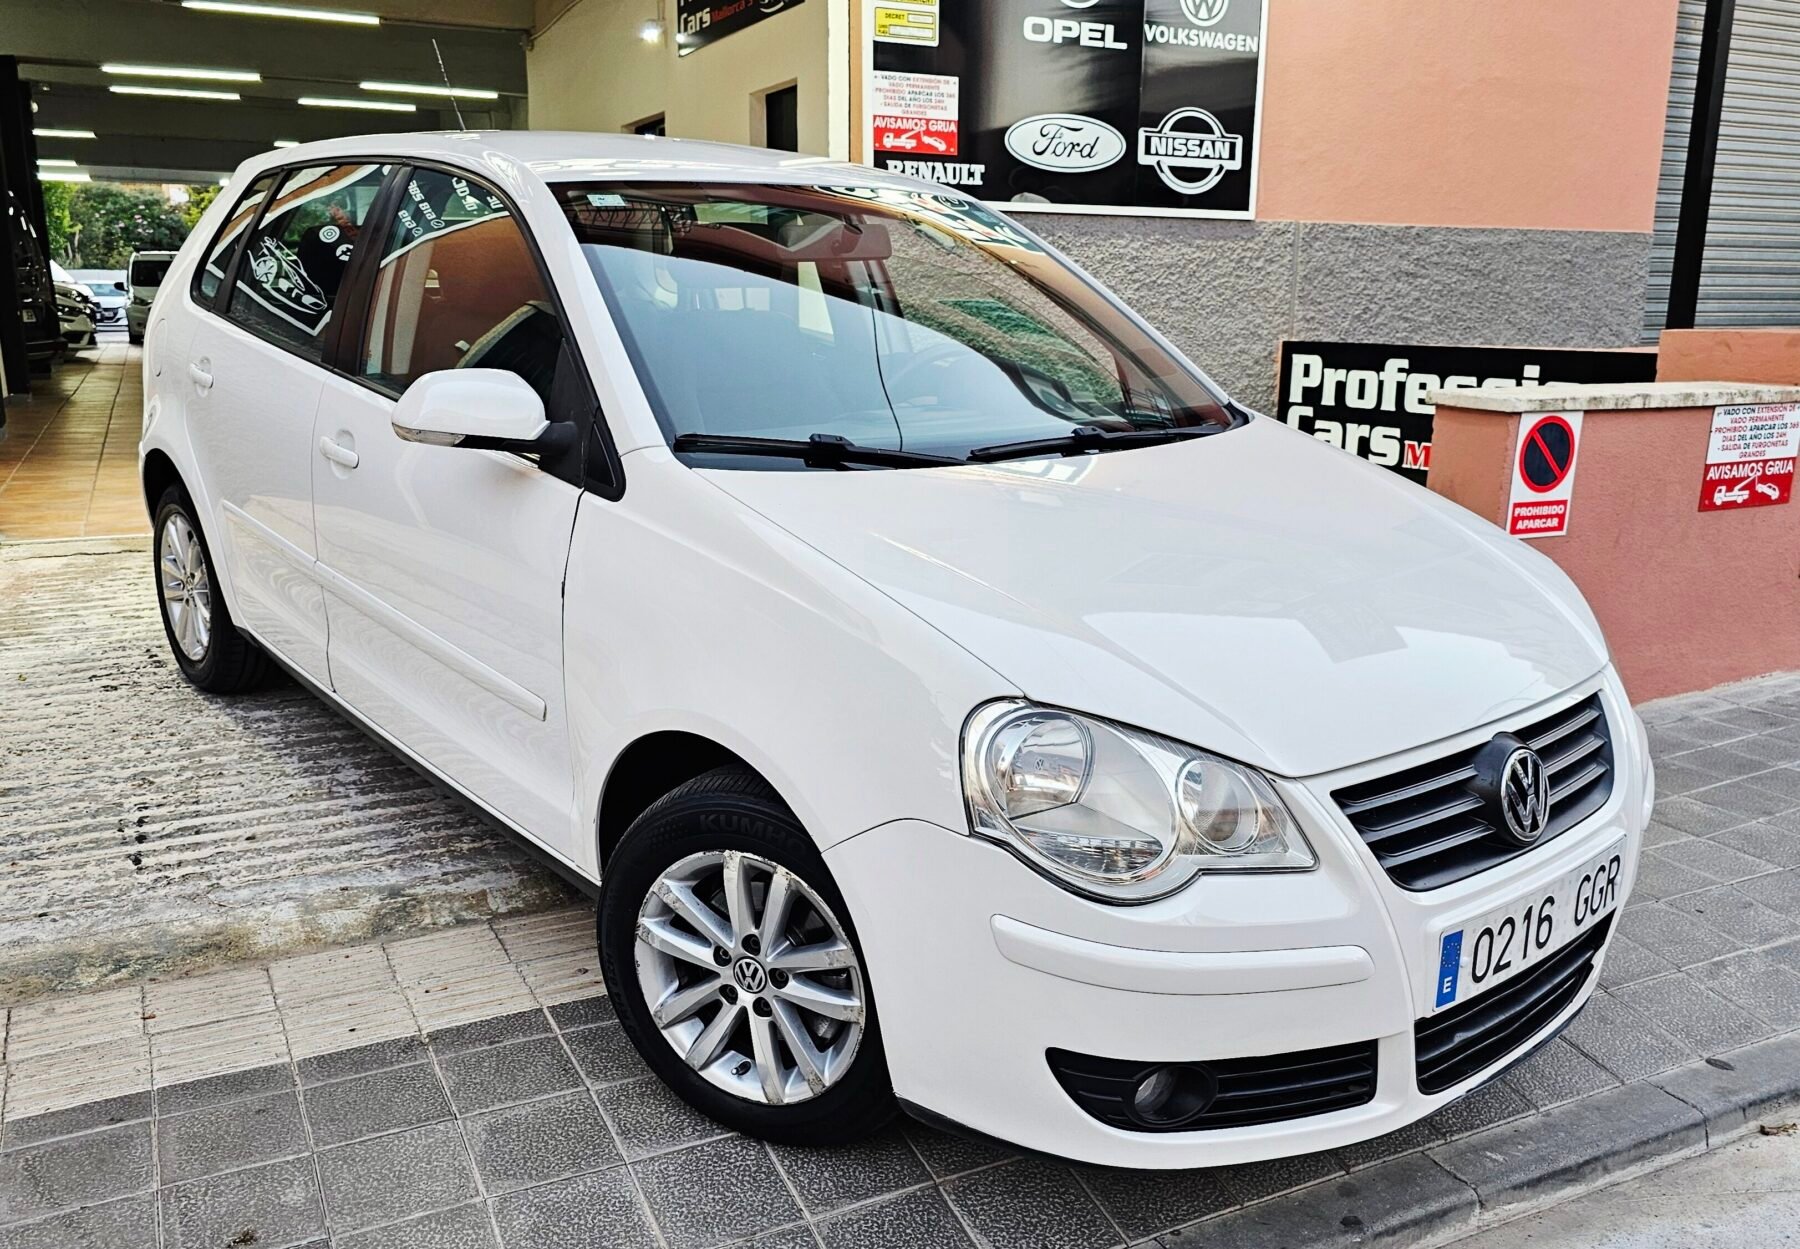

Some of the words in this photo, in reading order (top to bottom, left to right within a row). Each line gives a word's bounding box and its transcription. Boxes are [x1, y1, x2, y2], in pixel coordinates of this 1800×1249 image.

[1023, 16, 1128, 50] OPEL
[1144, 23, 1258, 53] VOLKSWAGEN
[874, 116, 927, 131] AVISAMOS
[928, 120, 957, 133] GRUA
[1032, 122, 1100, 160] Ford
[1150, 136, 1231, 160] NISSAN
[886, 159, 985, 186] RENAULT
[1723, 407, 1741, 416] VADO
[1741, 407, 1756, 415] CON
[1788, 404, 1796, 412] DE
[1730, 416, 1747, 424] VADO
[1748, 414, 1785, 424] PERMANENTE
[1714, 425, 1748, 434] PROHIBIDO
[1749, 423, 1777, 432] APARCAR
[1777, 422, 1788, 430] LOS
[1721, 443, 1742, 451] SALIDA
[1743, 442, 1750, 450] DE
[1751, 440, 1788, 449] FURGONETAS
[1722, 434, 1737, 443] DIAS
[1737, 434, 1748, 442] DEL
[1749, 432, 1763, 441] AÑO
[1763, 432, 1775, 440] LOS
[1739, 450, 1766, 459] GRANDES
[1706, 462, 1763, 480] AVISAMOS
[1765, 459, 1794, 476] GRUA
[1513, 504, 1565, 517] PROHIBIDO
[1515, 517, 1559, 530] APARCAR
[1471, 895, 1555, 984] 0216
[1574, 854, 1621, 927] GGR
[1442, 976, 1453, 994] E
